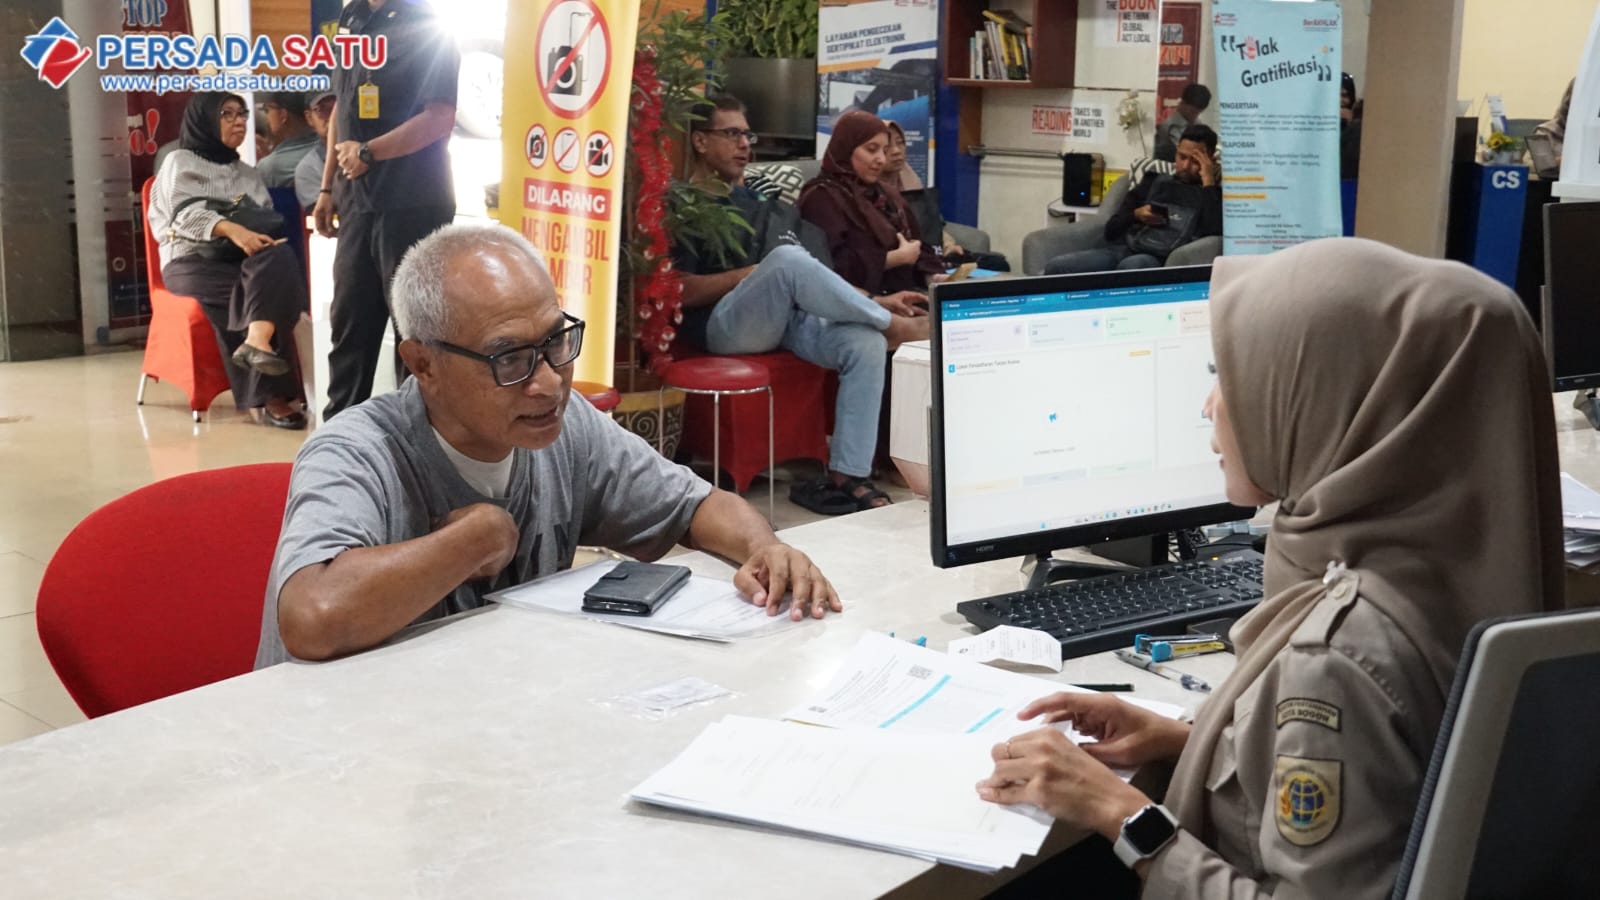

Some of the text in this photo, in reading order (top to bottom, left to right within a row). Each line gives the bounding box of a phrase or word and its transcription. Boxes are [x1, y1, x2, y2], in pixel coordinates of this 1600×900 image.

[1032, 109, 1072, 132] READING
[1492, 170, 1521, 189] CS
[527, 184, 607, 214] DILARANG
